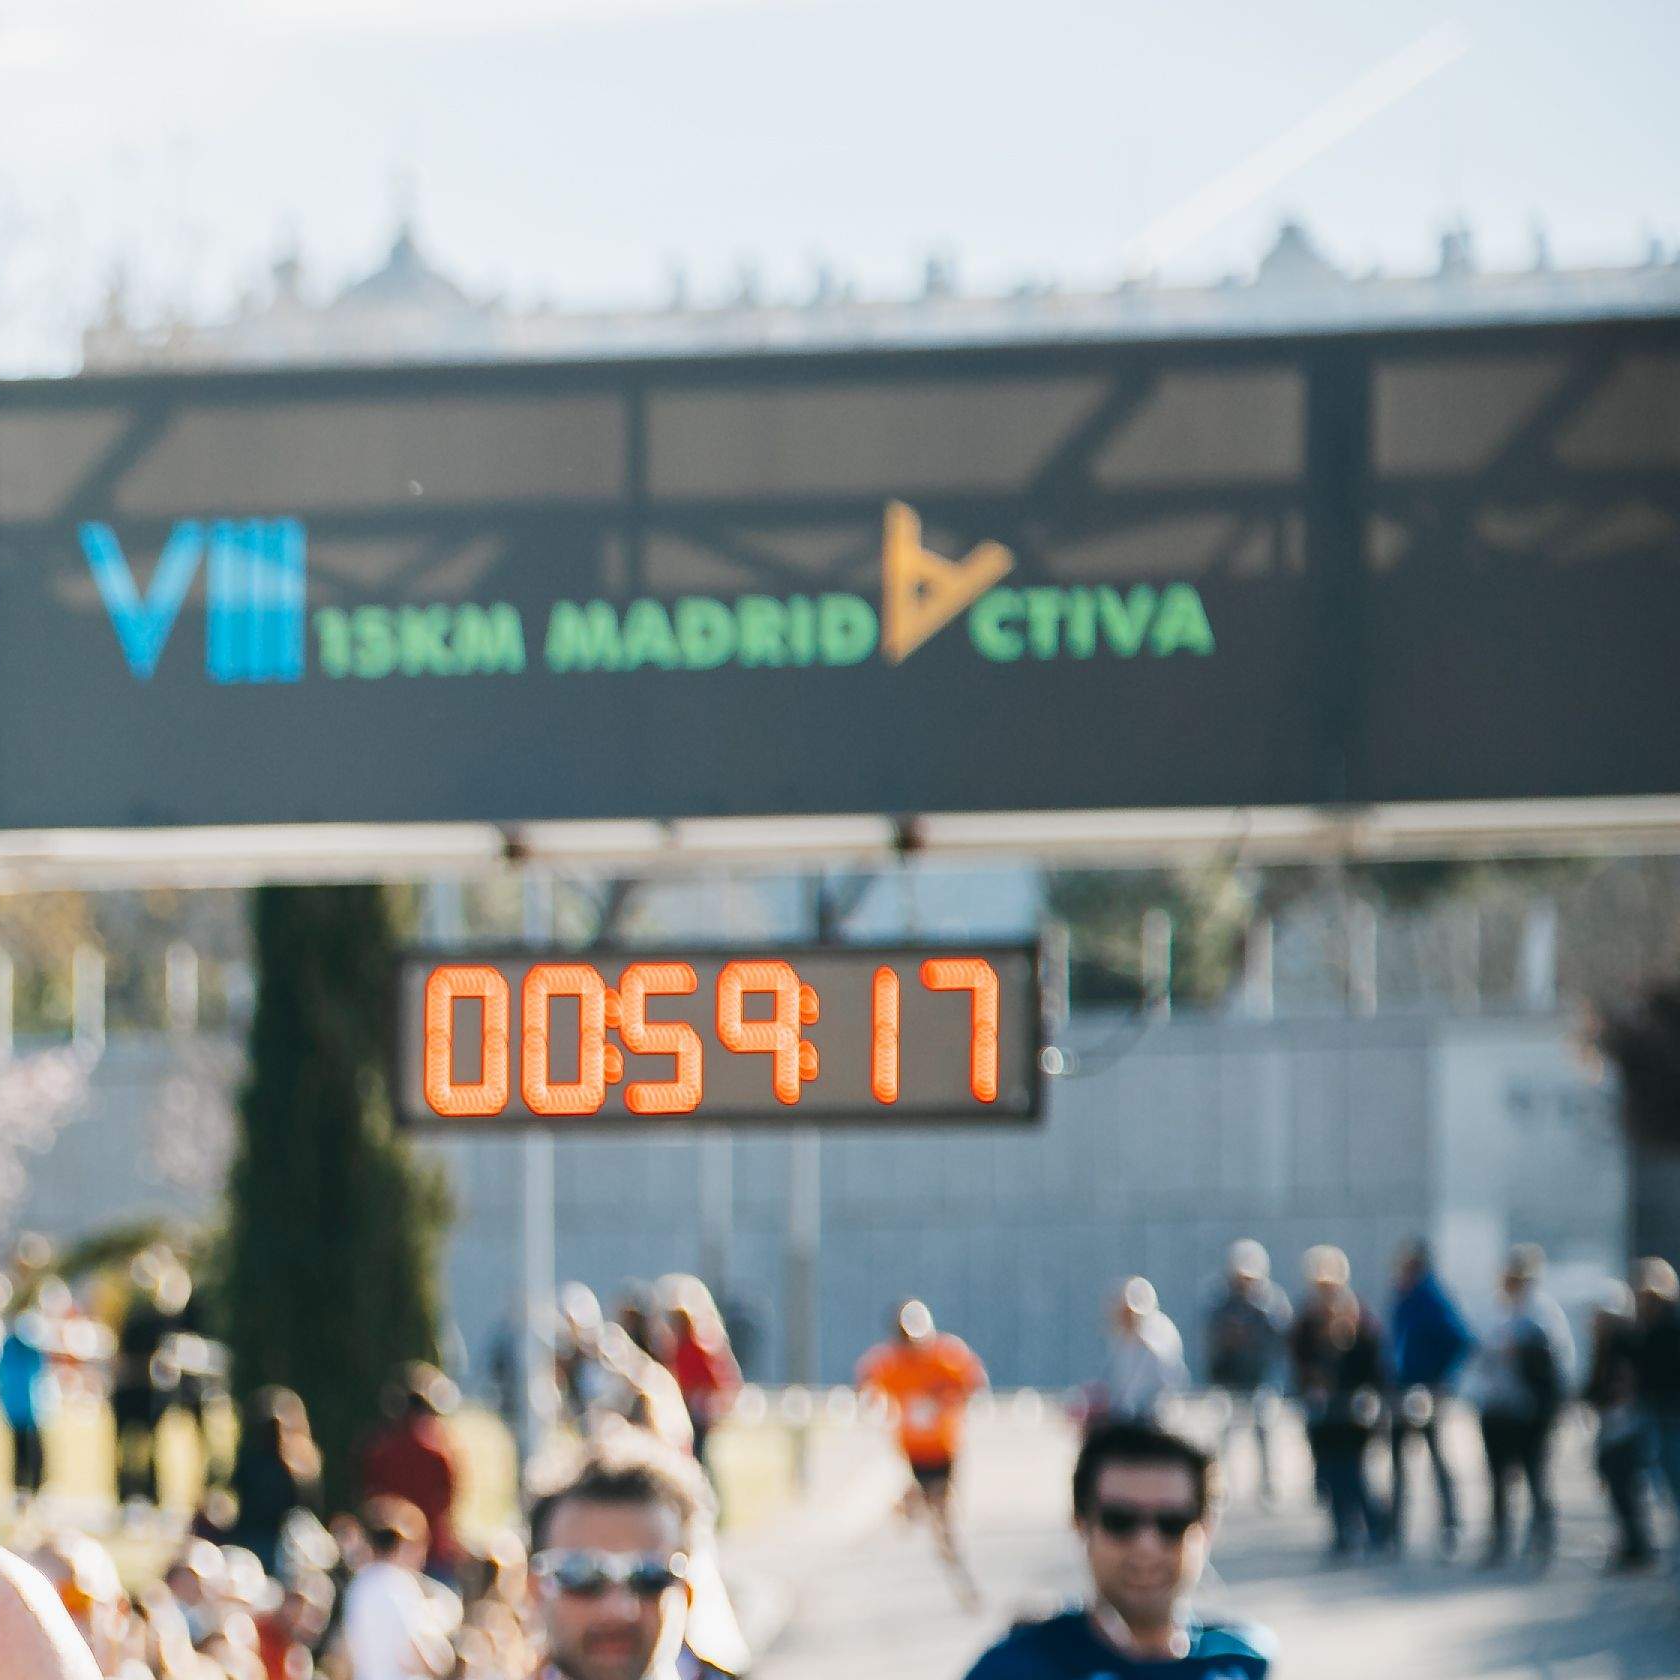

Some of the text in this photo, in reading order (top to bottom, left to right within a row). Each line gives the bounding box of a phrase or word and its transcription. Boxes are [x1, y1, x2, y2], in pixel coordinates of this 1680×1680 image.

[78, 518, 305, 682] VIII
[314, 603, 526, 679] 15KM
[545, 596, 879, 674] MADRID
[425, 958, 998, 1117] 00:59:17
